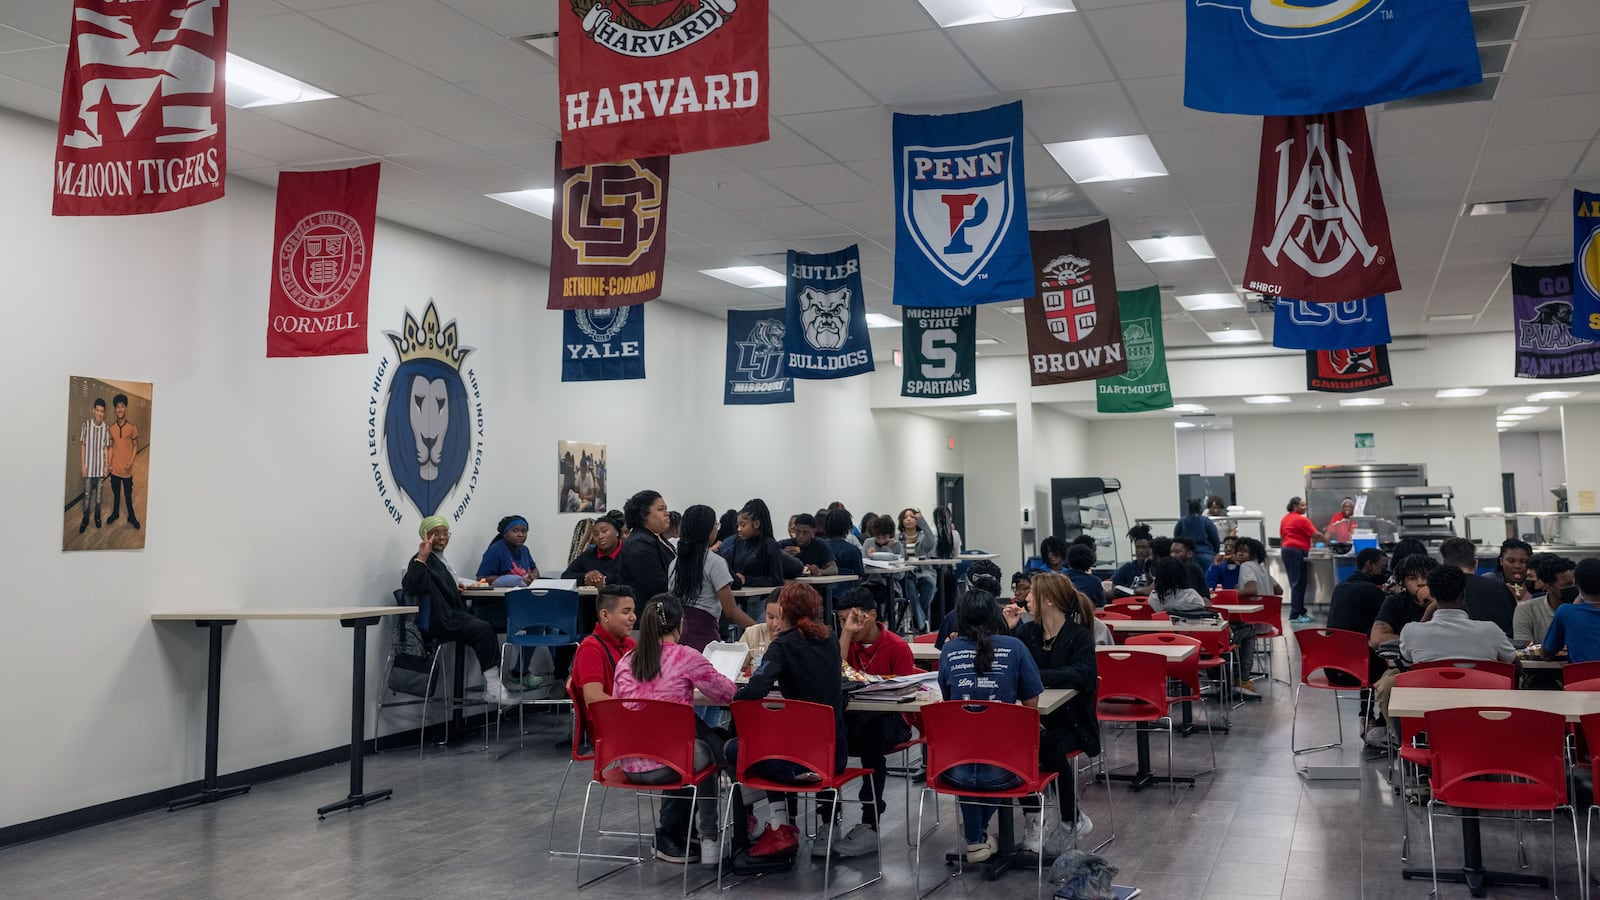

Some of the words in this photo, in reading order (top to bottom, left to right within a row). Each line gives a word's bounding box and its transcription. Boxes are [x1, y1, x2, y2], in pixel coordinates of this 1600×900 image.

[596, 9, 717, 53] HARVARD
[566, 70, 759, 131] HARVARD
[57, 160, 133, 197] MAROON
[137, 147, 219, 194] TIGERS
[914, 150, 1004, 181] PENN
[941, 193, 989, 255] P
[563, 270, 656, 298] BETHUNE-COOKMAN
[792, 258, 860, 280] BUTLER
[281, 266, 320, 308] FOUNDED
[1249, 280, 1282, 295] #HBCU
[1538, 277, 1569, 295] GO
[273, 312, 359, 333] CORNELL
[906, 306, 972, 319] MICHIGAN
[919, 318, 959, 329] STATE
[567, 341, 639, 359] YALE
[788, 349, 869, 371] BULLDOGS
[920, 328, 958, 379] S
[1033, 341, 1122, 375] BROWN
[373, 357, 389, 391] HIGH
[467, 368, 480, 399] KIPP
[906, 378, 971, 394] SPARTANS
[1099, 382, 1167, 395] DARTMOUTH
[1311, 376, 1389, 389] CARDINALS
[367, 397, 377, 456] LEGACY
[475, 402, 485, 438] INDY
[371, 462, 385, 497] INDY
[468, 441, 484, 493] LEGACY
[384, 497, 402, 524] KIPP
[453, 492, 471, 522] HIGH
